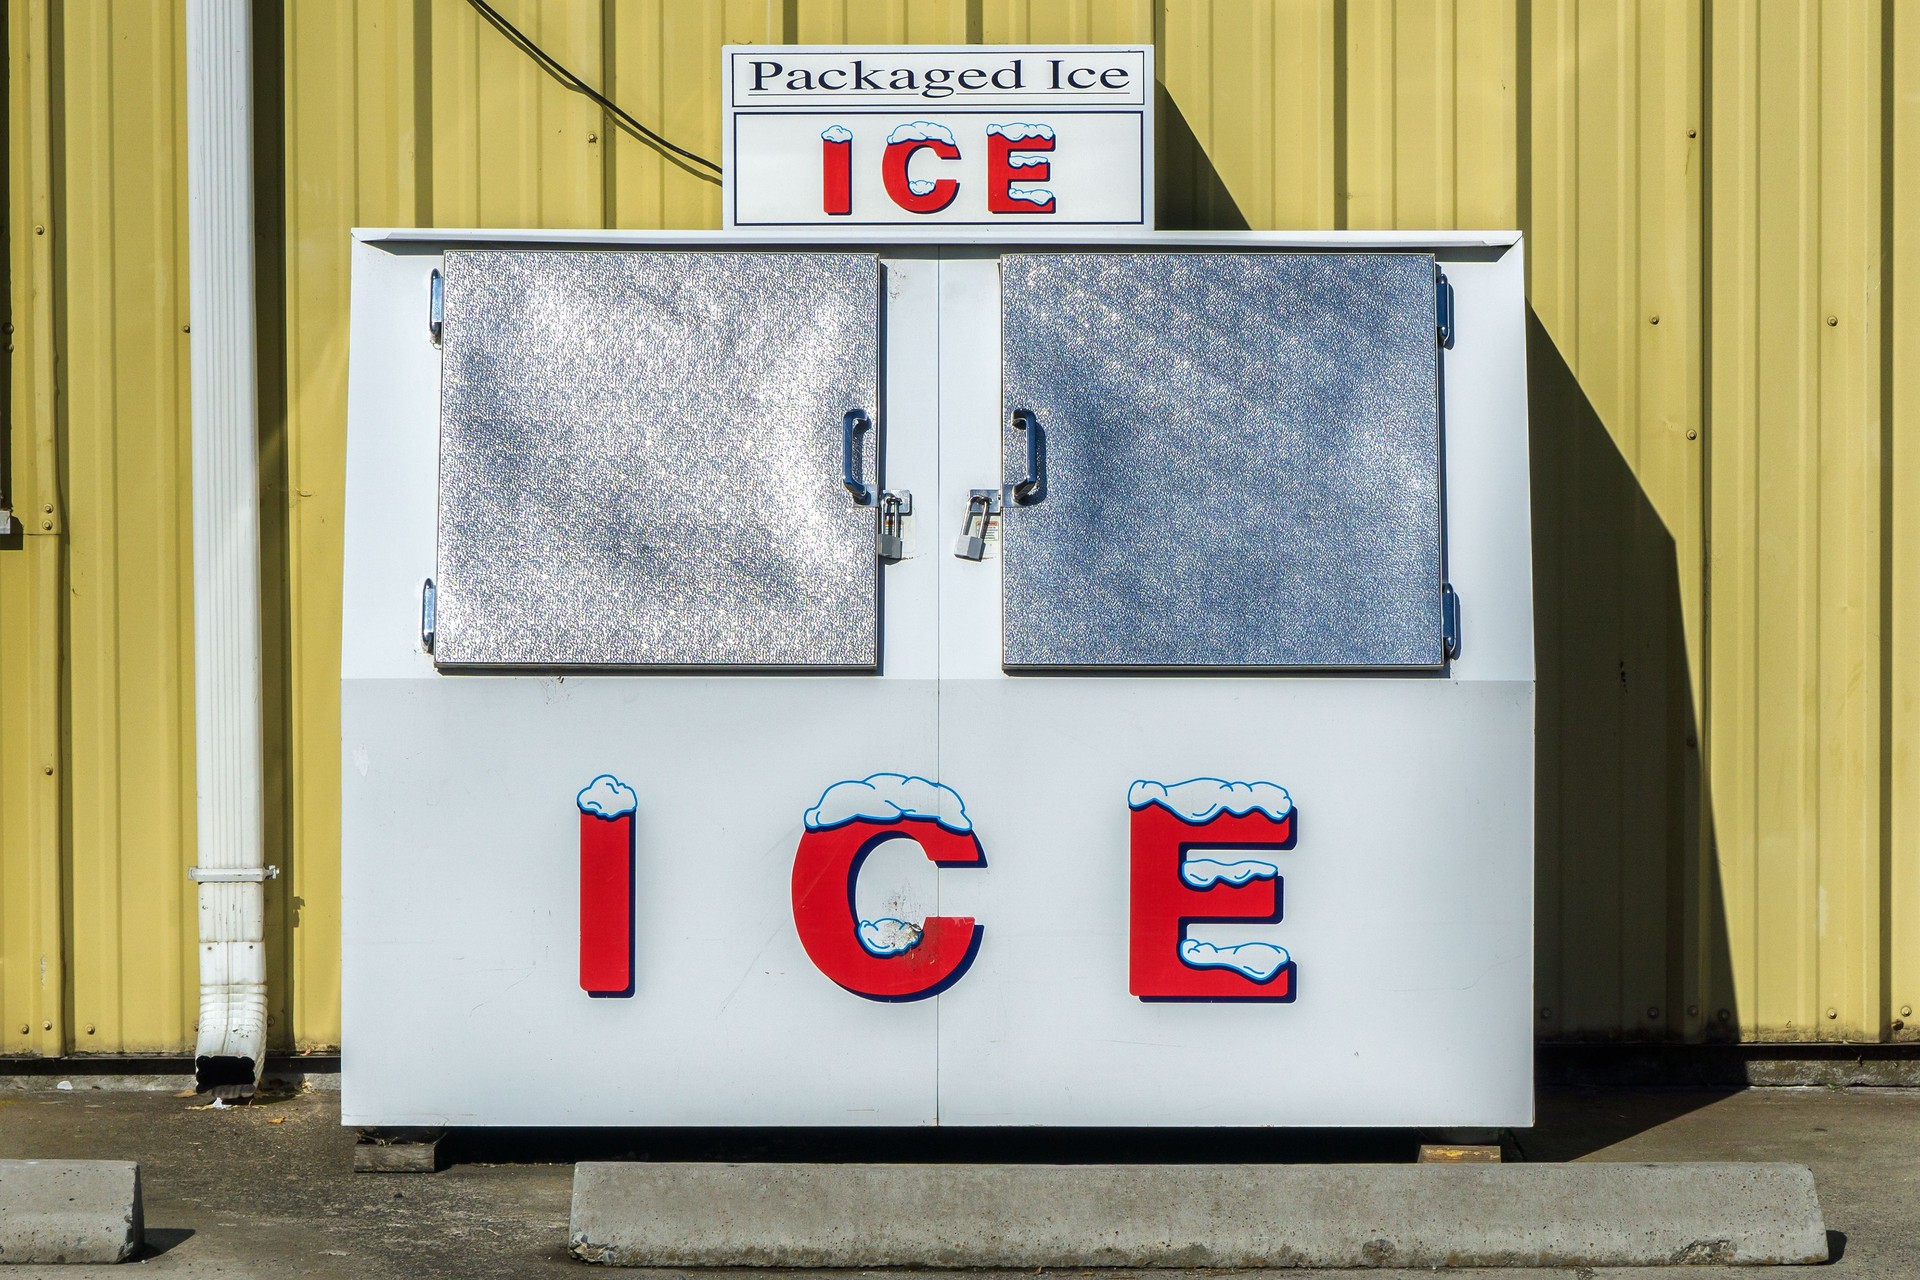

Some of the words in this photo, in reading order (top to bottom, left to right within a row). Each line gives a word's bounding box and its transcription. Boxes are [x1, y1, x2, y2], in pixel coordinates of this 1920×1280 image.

[748, 59, 1025, 98] Packaged
[1046, 60, 1130, 90] Ice
[821, 121, 1056, 214] ICE
[577, 773, 1298, 1003] ICE
